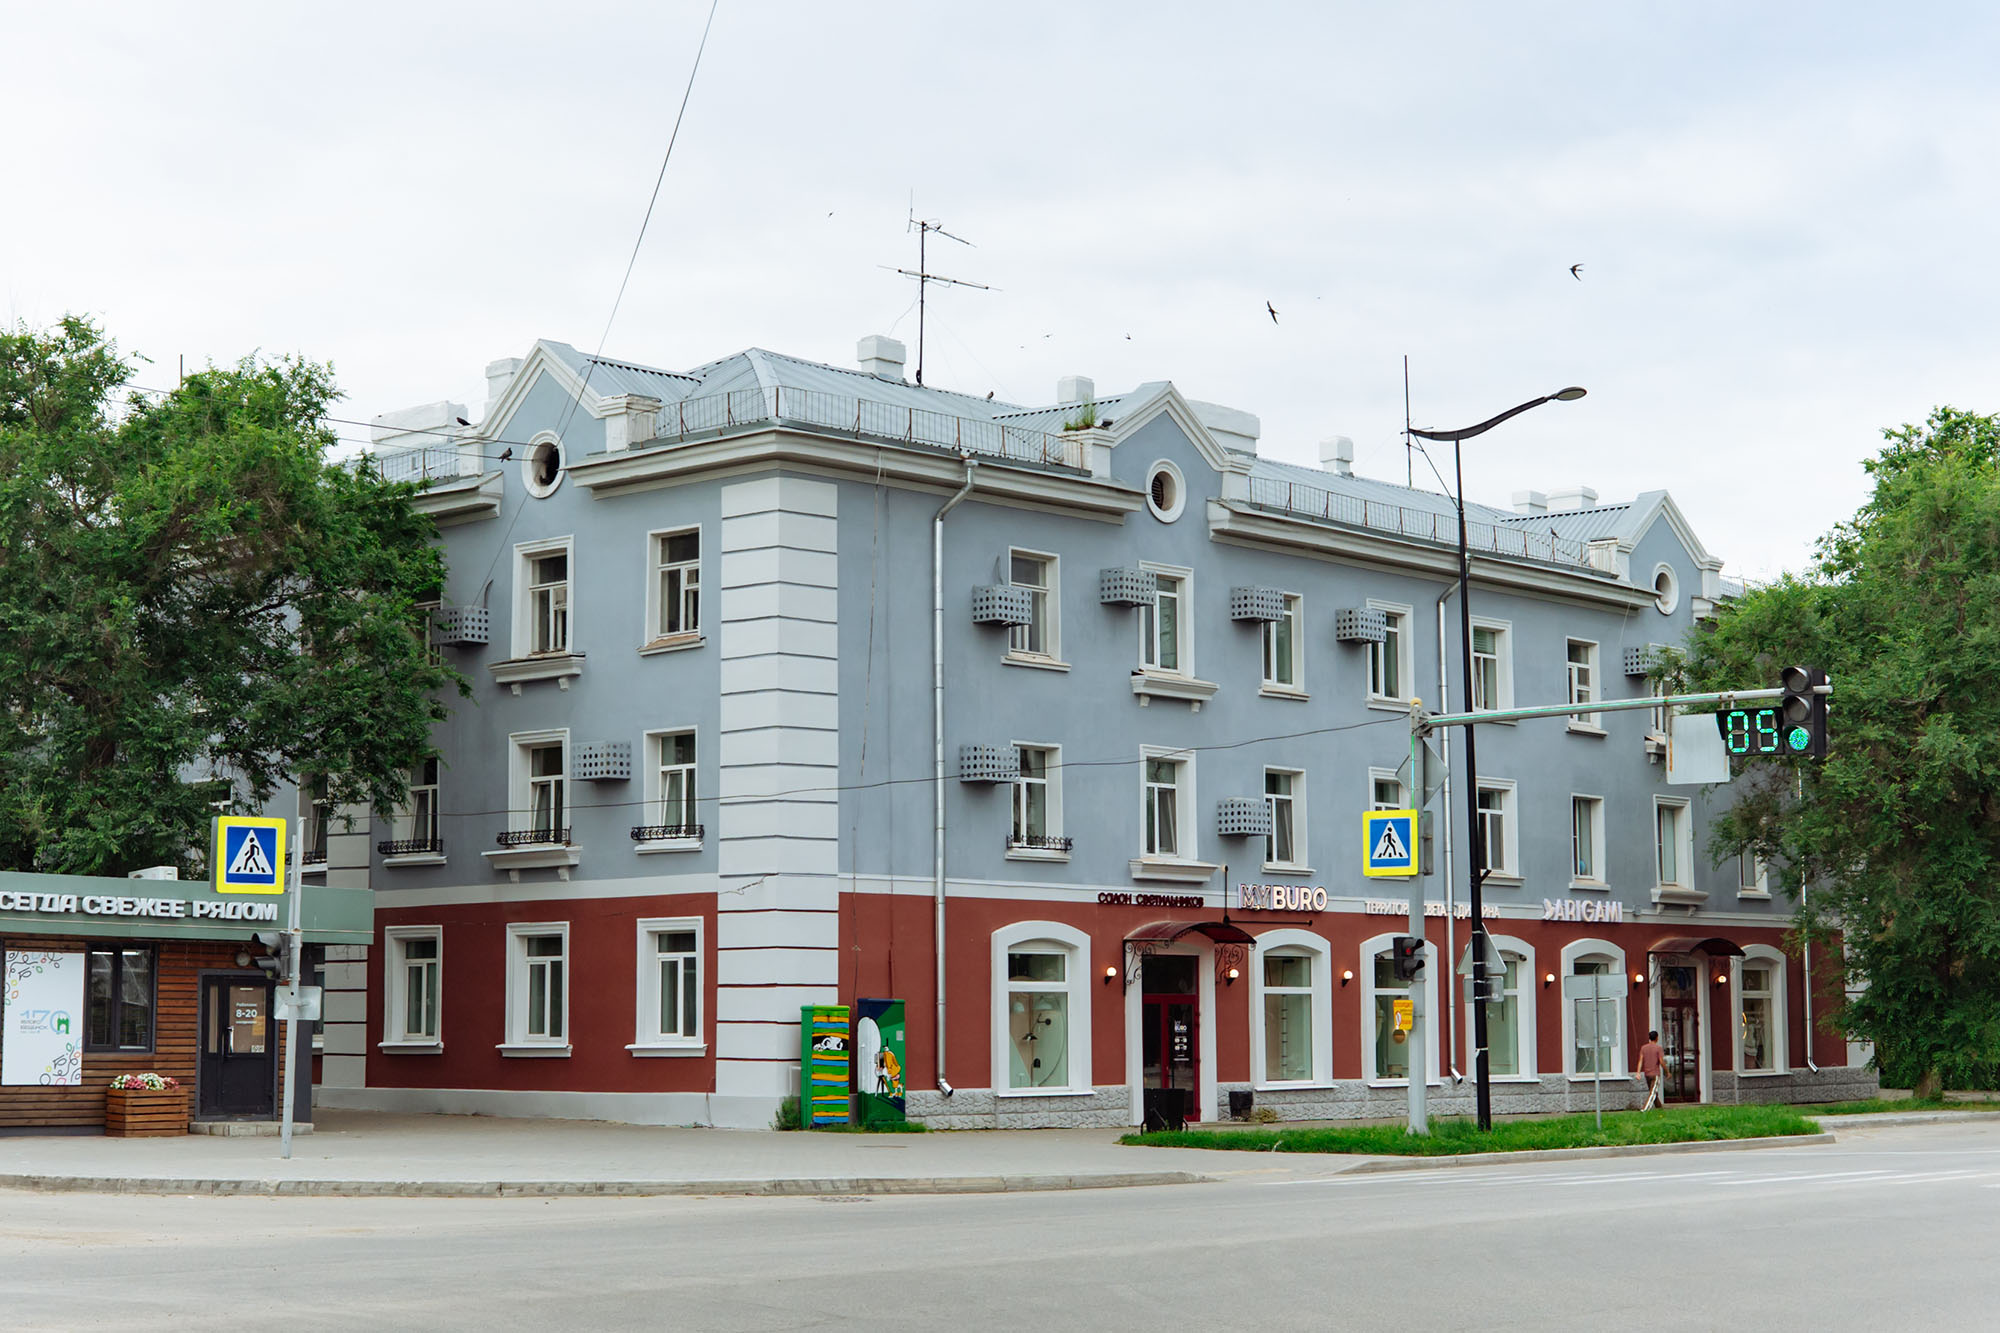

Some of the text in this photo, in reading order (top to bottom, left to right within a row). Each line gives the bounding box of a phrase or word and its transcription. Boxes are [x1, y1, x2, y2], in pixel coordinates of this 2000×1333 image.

[1727, 710, 1778, 753] 05
[0, 891, 278, 921] СЕГДА СВЕЖЕЕ РЯДОМ
[235, 1009, 257, 1018] 8-20
